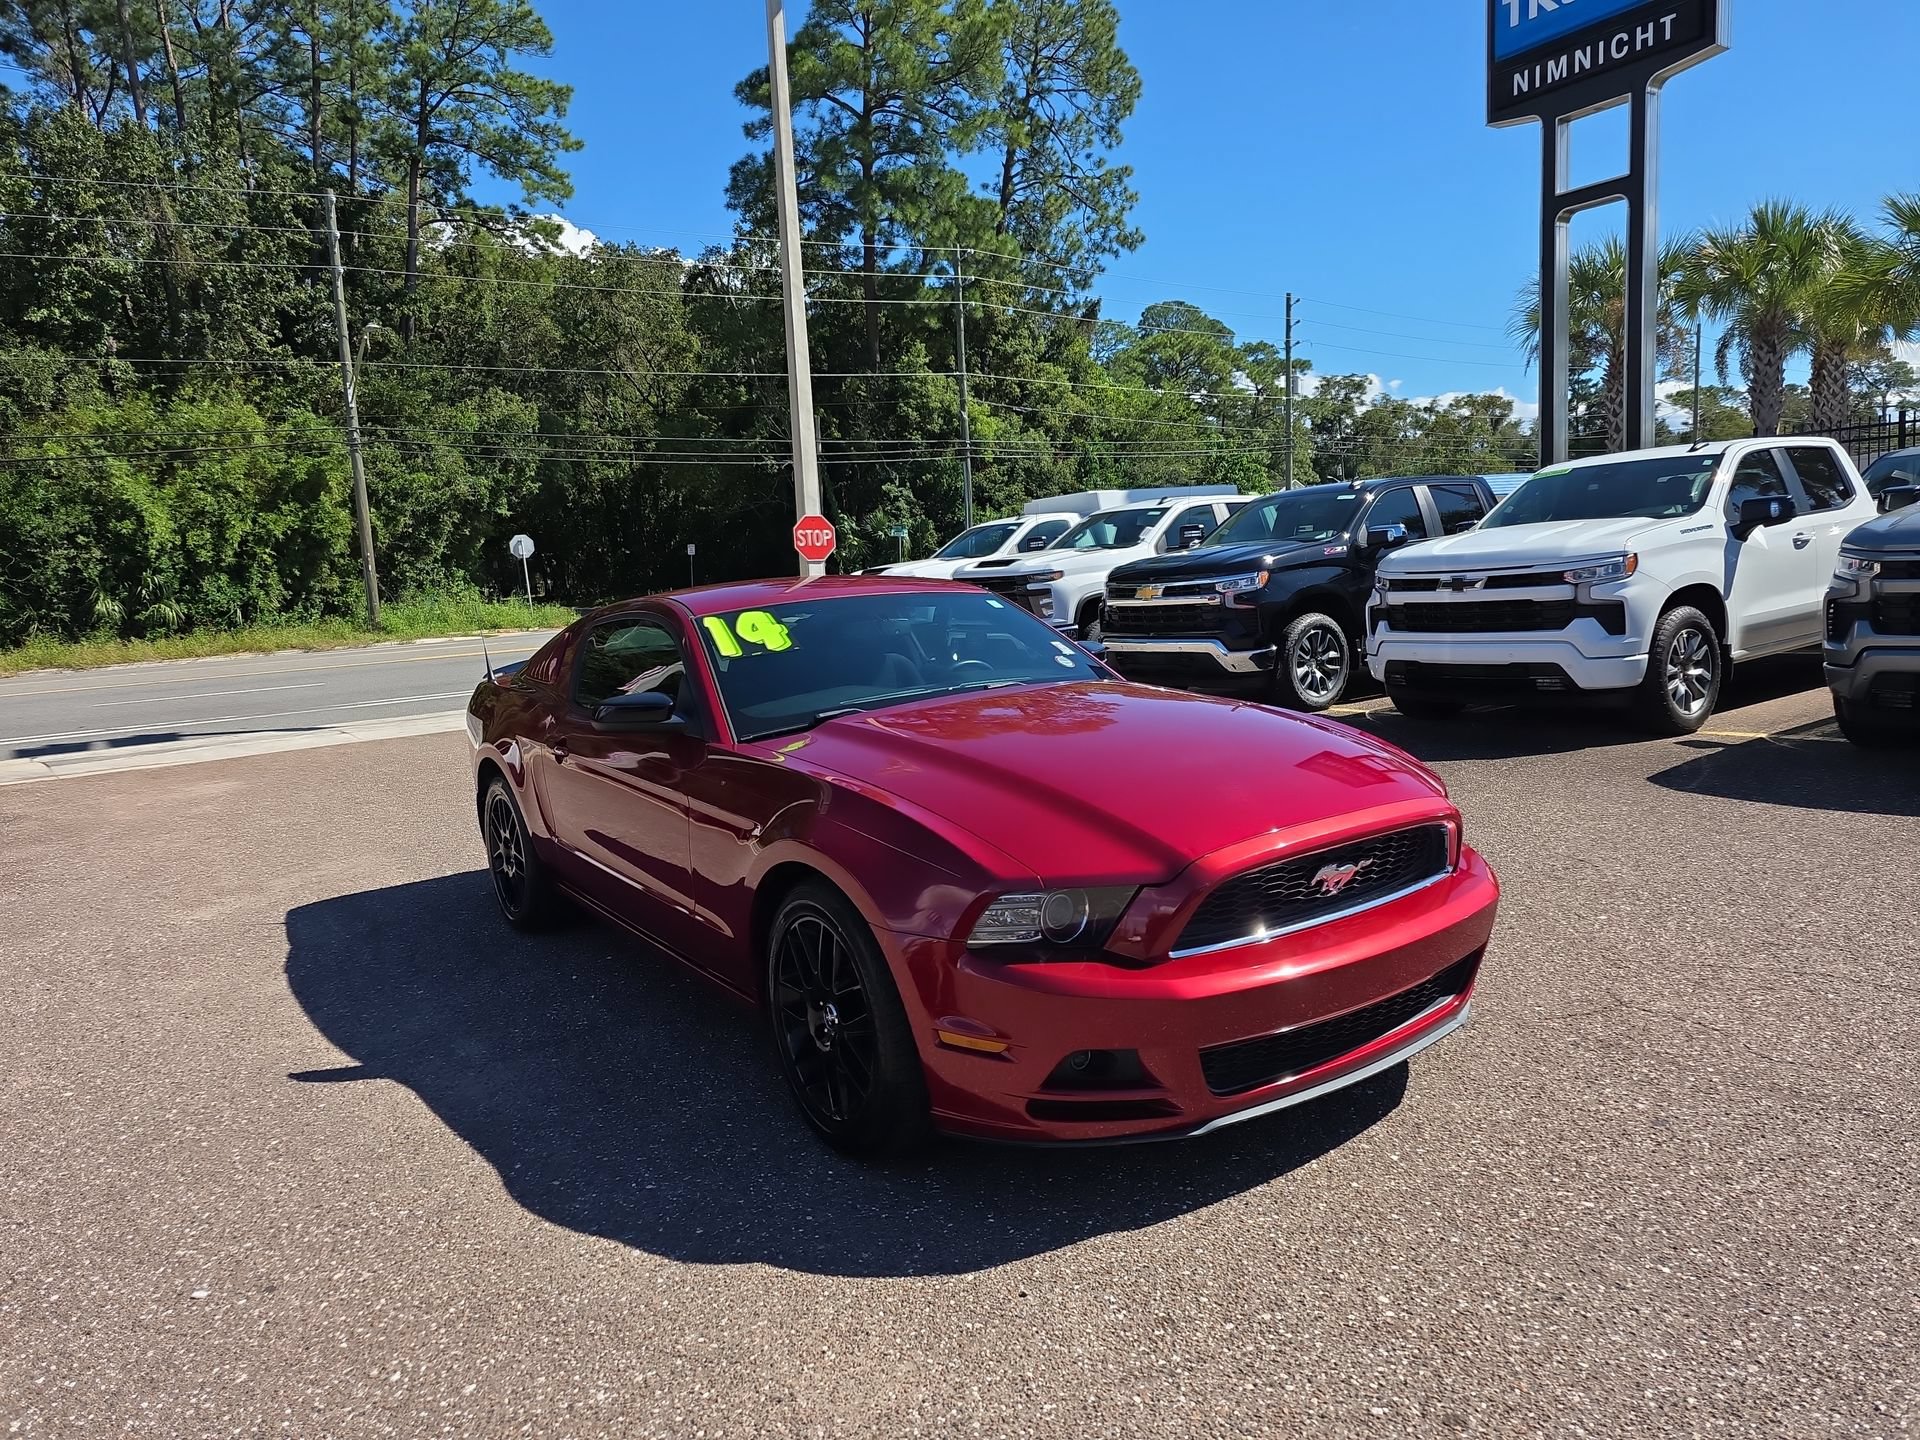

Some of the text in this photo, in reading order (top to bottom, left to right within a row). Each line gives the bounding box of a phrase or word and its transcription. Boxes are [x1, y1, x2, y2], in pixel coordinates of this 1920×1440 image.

[1512, 13, 1677, 97] NIMNICHT
[796, 529, 833, 547] STOP
[703, 610, 793, 658] 14
